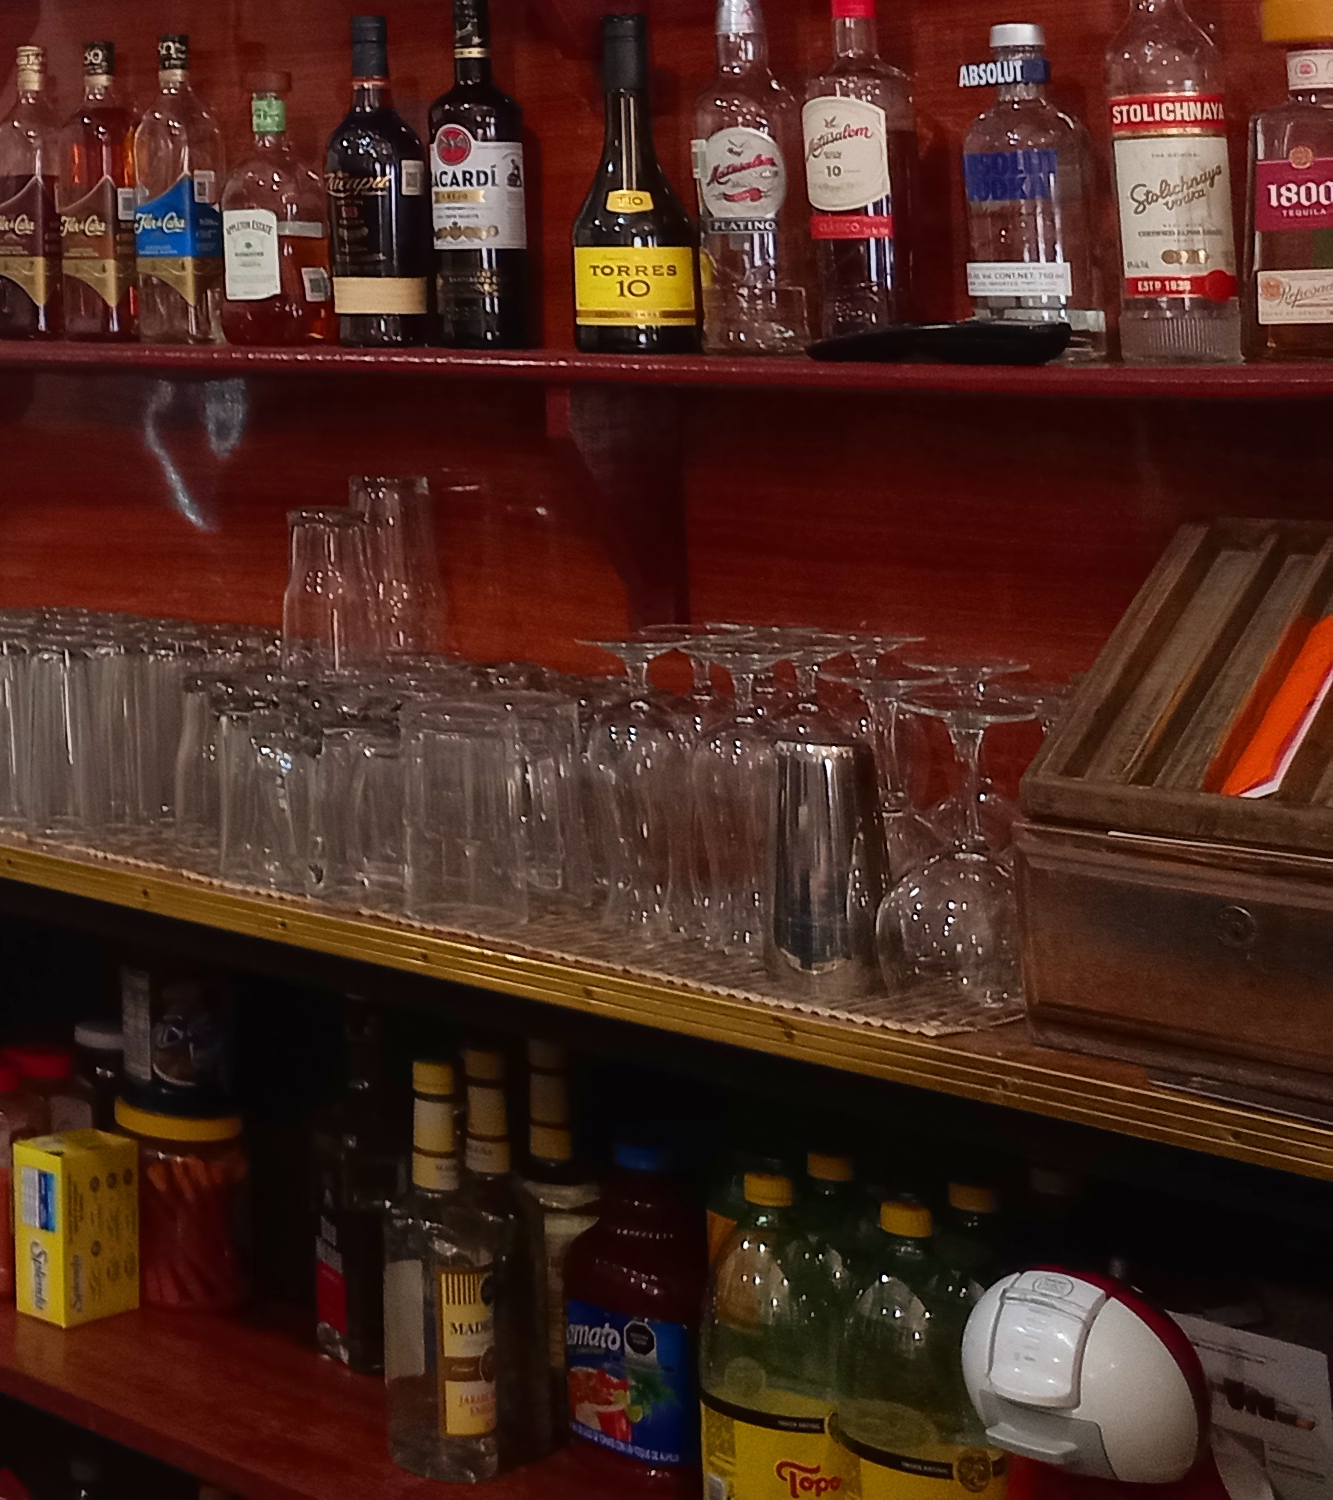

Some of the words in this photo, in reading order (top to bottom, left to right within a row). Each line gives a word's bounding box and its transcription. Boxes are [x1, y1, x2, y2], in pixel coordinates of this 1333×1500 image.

[959, 60, 1023, 87] ABSOLUT
[1112, 102, 1224, 124] STOLICHNAYA
[826, 165, 842, 177] 10
[1129, 164, 1222, 215] Stolichnaya
[1266, 180, 1333, 208] 1800
[1282, 209, 1326, 218] TEQUILA
[714, 221, 776, 231] PLATINO
[589, 265, 677, 277] TORRES
[616, 279, 651, 297] 10
[775, 1460, 841, 1498] Topo
